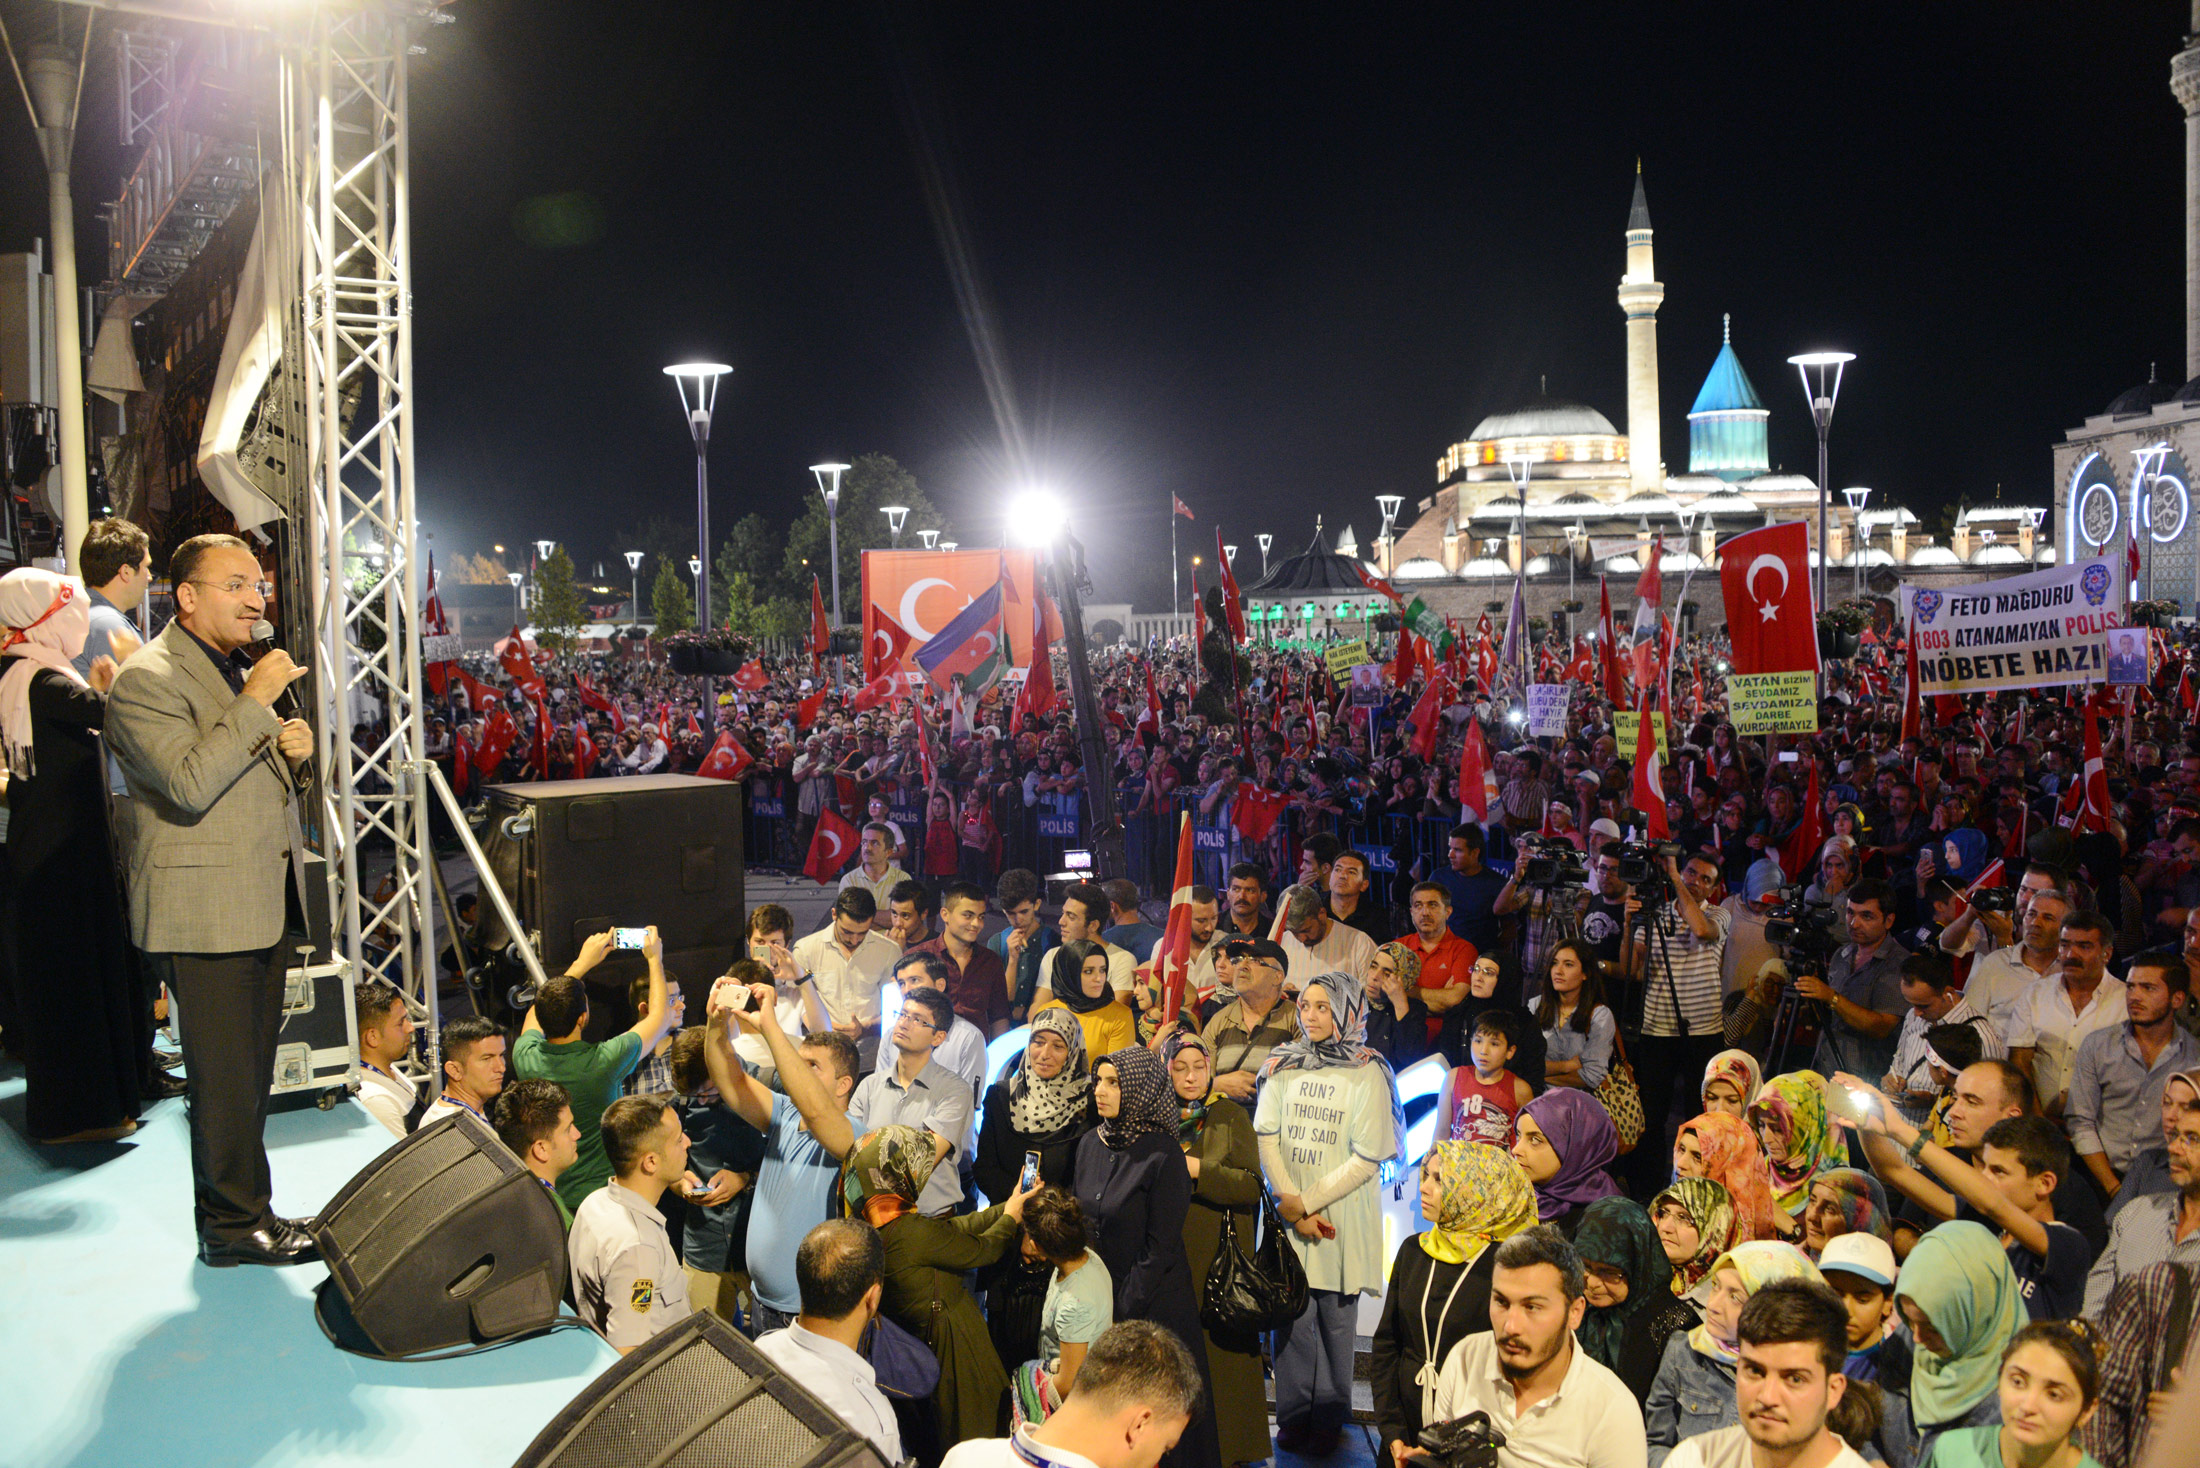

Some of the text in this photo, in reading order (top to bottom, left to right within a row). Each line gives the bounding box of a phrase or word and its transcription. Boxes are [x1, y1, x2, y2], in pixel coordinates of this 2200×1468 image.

[1950, 584, 2074, 616] FETO MAĞDURU
[1916, 630, 1950, 650] 1803
[1955, 619, 2060, 648] ATANAMAYAN
[1919, 643, 2106, 683] NÖBETE HAZI
[1733, 676, 1811, 688] VATAN BİZİM
[1745, 687, 1800, 698] SEVDAMIZ
[1732, 698, 1814, 711] SEVDAMIZA
[1755, 710, 1792, 720] DARBE
[1737, 720, 1813, 733] VURDURMAYIZ
[755, 802, 783, 815] POLİS
[889, 810, 919, 823] POLİS
[1039, 818, 1075, 834] POLİS
[1197, 830, 1225, 848] POLİS
[1366, 850, 1396, 868] OLİS
[1299, 1081, 1336, 1101] RUN?
[1286, 1103, 1346, 1125] I THOUGHT
[1462, 1094, 1484, 1117] 18
[1287, 1125, 1338, 1145] YOU SAID
[1292, 1147, 1323, 1166] FUN!
